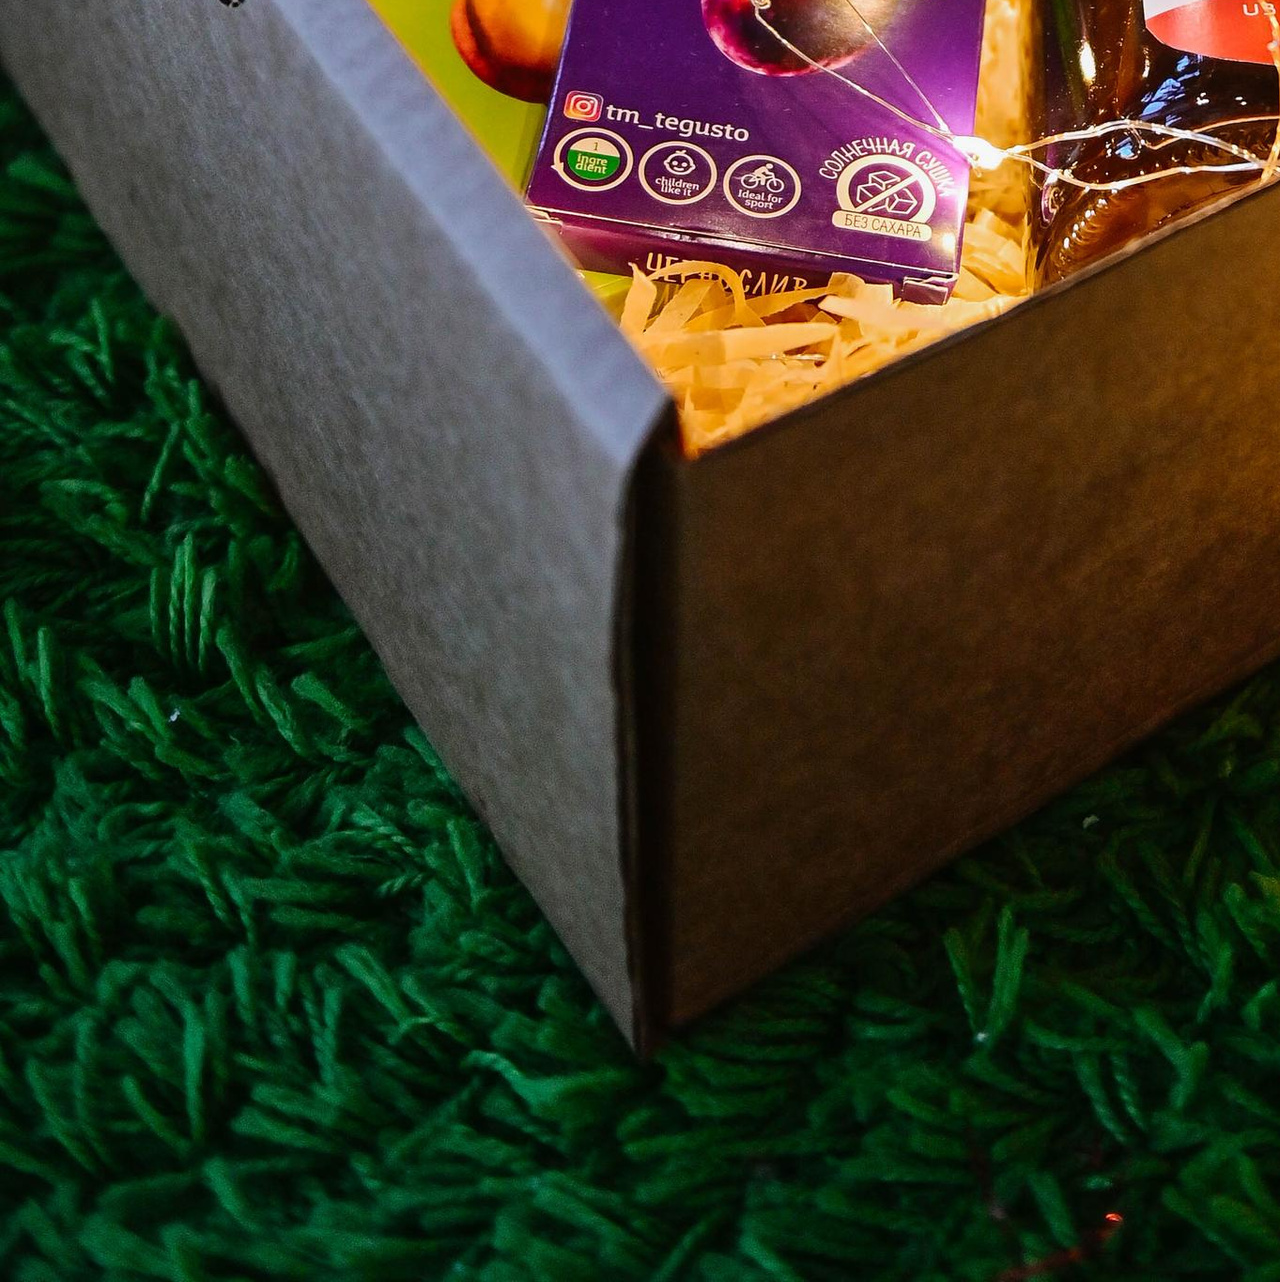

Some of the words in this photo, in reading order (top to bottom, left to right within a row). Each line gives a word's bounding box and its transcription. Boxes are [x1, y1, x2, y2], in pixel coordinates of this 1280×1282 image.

[606, 104, 750, 142] tm_tegusto
[577, 153, 608, 166] ingre
[818, 137, 916, 180] СОЛНЕЧНАЯ
[575, 161, 608, 175] dient
[655, 175, 700, 191] children
[660, 184, 681, 196] like
[683, 187, 692, 197] it
[738, 189, 765, 201] Ideal
[767, 193, 784, 204] for
[744, 199, 774, 210] sport
[844, 213, 868, 229] БЕЗ
[871, 218, 922, 238] САХАРА
[646, 252, 808, 298] ЧЕСЛИВ
